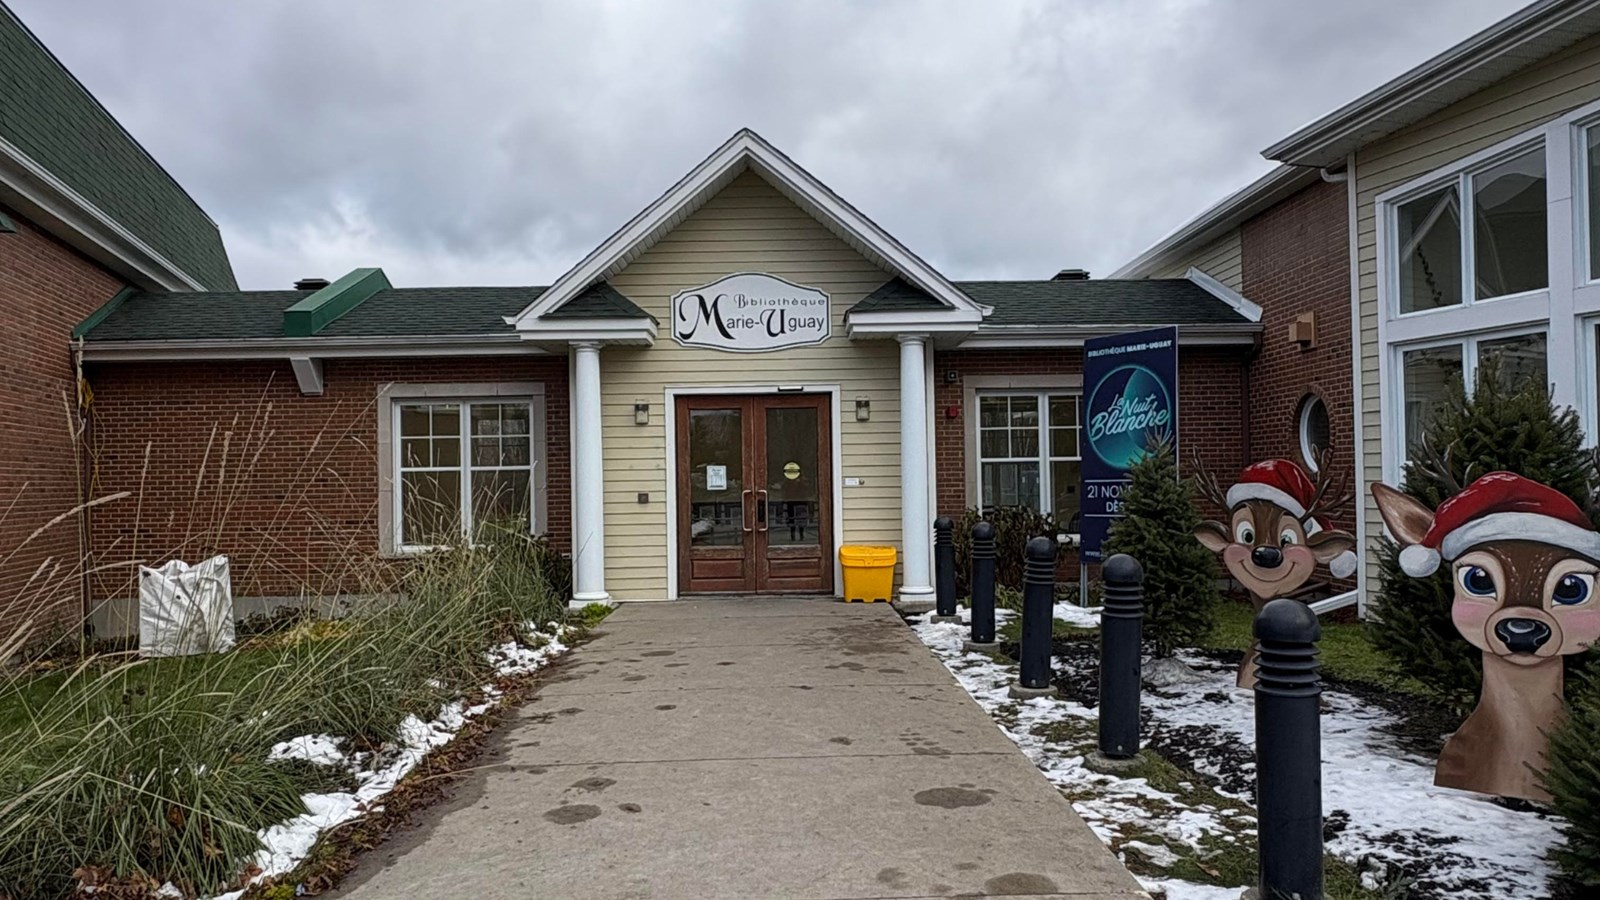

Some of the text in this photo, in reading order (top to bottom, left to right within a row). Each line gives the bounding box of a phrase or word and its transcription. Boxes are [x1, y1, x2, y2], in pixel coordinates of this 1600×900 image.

[734, 294, 825, 309] Bibliothèque
[678, 294, 825, 340] Marie-Uguay
[1108, 394, 1157, 417] La Nuit
[1091, 401, 1169, 441] Blanche
[1087, 485, 1098, 498] 21
